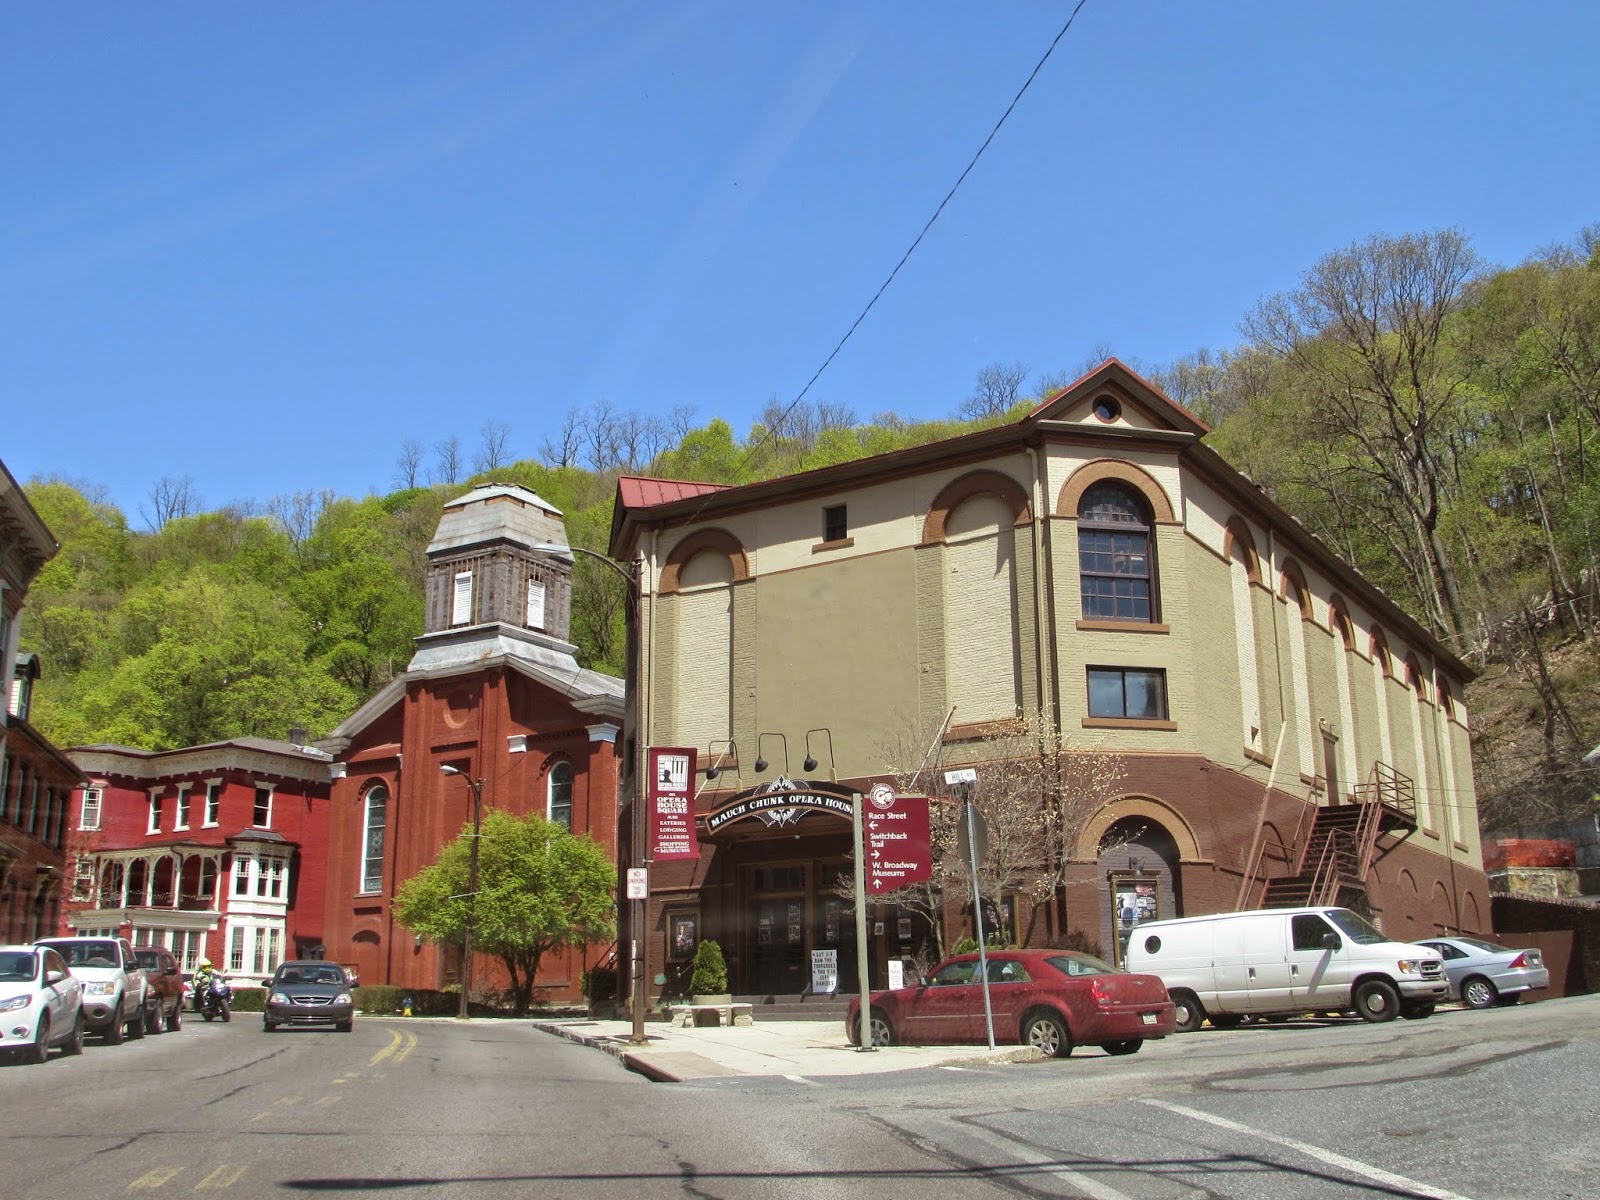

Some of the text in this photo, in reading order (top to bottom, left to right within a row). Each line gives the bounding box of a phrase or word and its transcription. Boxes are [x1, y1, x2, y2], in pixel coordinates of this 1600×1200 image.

[711, 804, 746, 828] MAUCH
[749, 795, 785, 810] CHUNK
[789, 795, 822, 805] OPERA
[868, 812, 907, 820] Race Street
[870, 832, 908, 840] Switchback
[870, 840, 884, 848] Trail
[884, 861, 918, 871] Broadway
[633, 870, 641, 878] NO
